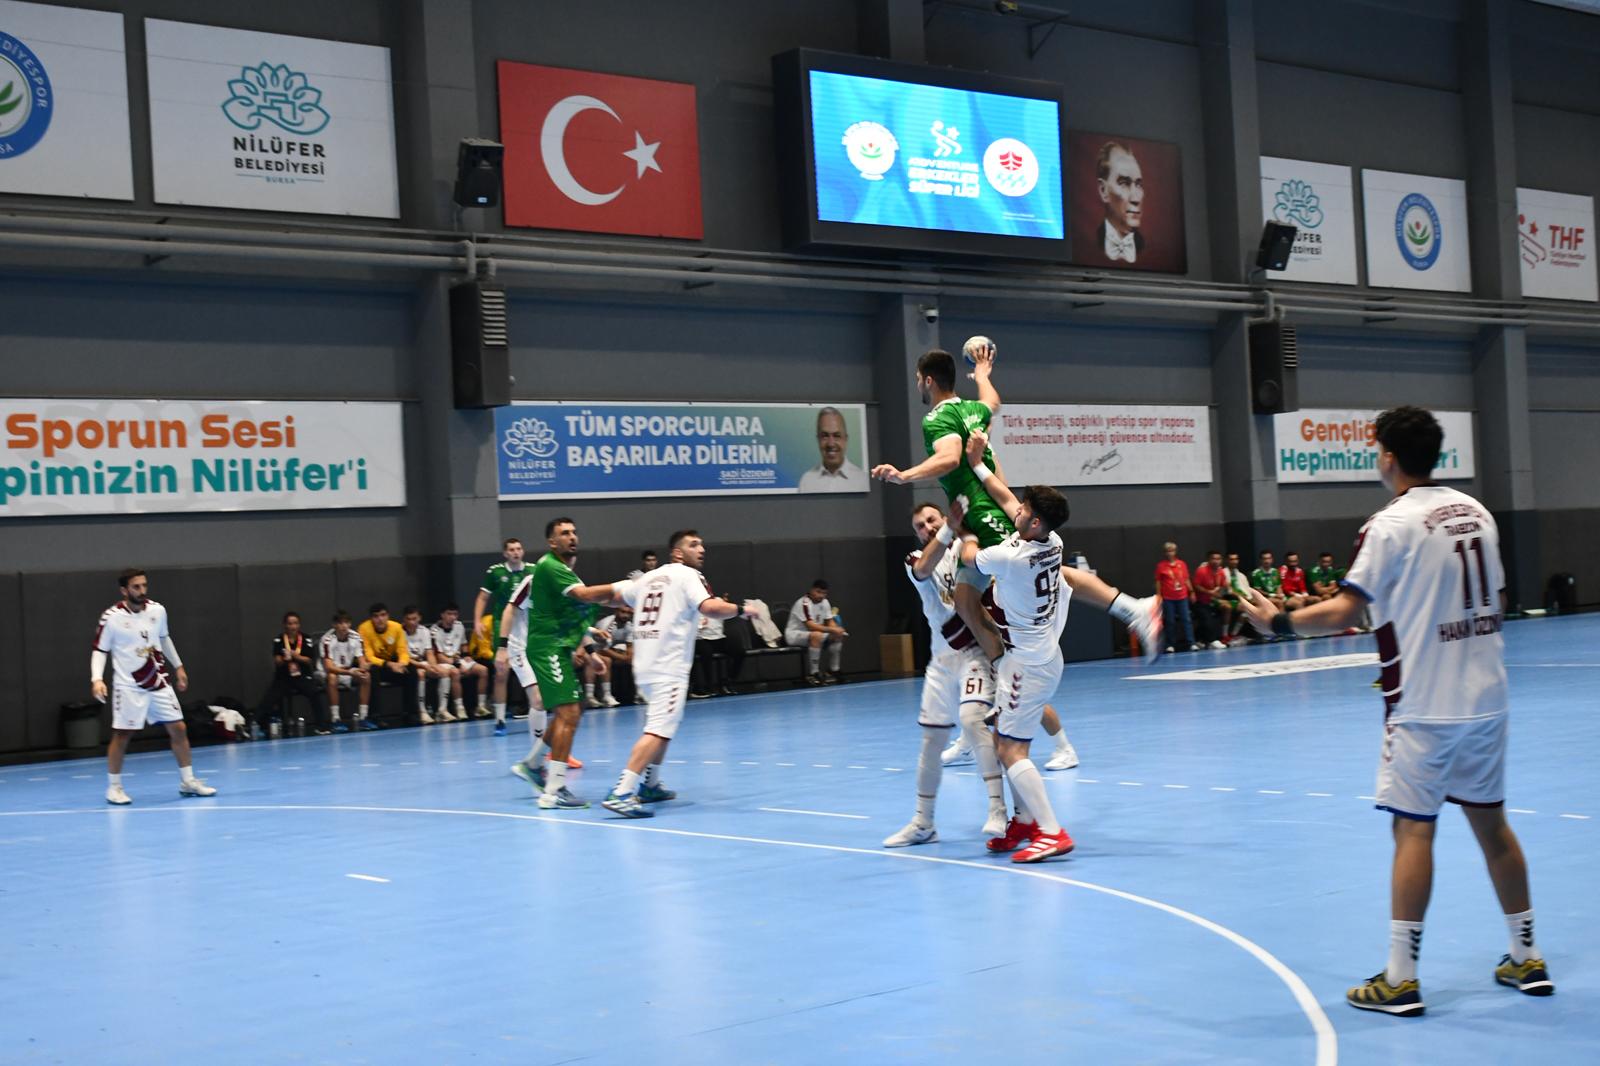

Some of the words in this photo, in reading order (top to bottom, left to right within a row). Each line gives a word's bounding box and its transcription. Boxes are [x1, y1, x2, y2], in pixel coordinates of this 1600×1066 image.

[1, 40, 49, 108] DİYESPOR
[233, 133, 326, 158] NİLÜFER
[234, 157, 325, 175] BELEDİYESİ
[1296, 230, 1322, 244] ÜFER
[1549, 224, 1585, 251] THF
[5, 413, 188, 457] Sporun
[201, 414, 296, 448] Sesi
[564, 410, 616, 437] TÜM
[620, 415, 764, 438] SPORCULARA
[1002, 415, 1024, 427] Türk
[1138, 417, 1158, 430] spor
[1160, 417, 1195, 430] yaparsa
[1301, 418, 1377, 447] Gençliğ
[1003, 433, 1064, 445] ulusumuzun
[1067, 431, 1107, 446] geleceği
[1110, 431, 1147, 446] güvence
[567, 444, 692, 473] BAŞARILAR
[696, 439, 777, 465] DİLERİM
[0, 460, 178, 504] pimizin
[192, 458, 367, 494] Nilüfer'i
[1453, 537, 1491, 610] 11
[965, 677, 983, 695] 61
